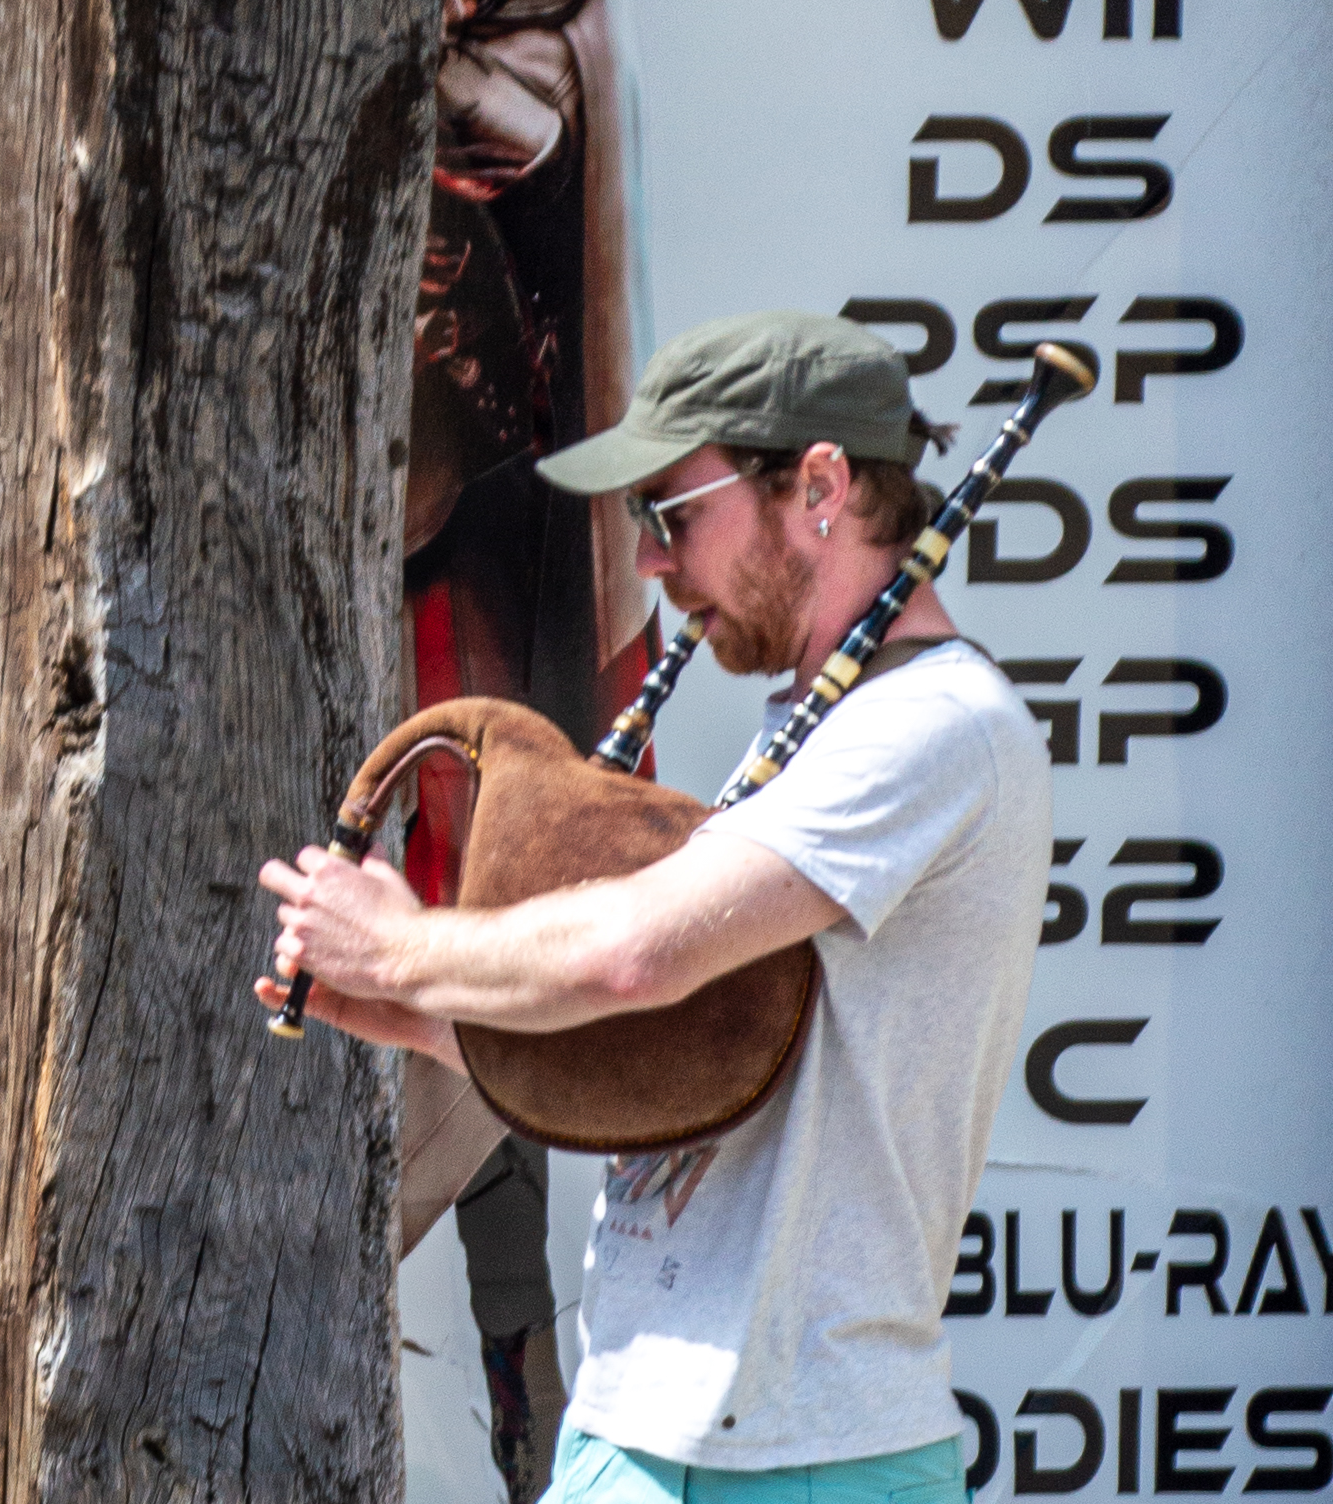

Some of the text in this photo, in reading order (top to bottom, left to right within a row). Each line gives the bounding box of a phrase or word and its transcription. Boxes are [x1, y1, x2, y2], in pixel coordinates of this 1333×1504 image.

[907, 113, 1174, 224] DS
[838, 294, 1245, 404] PSP
[916, 474, 1235, 586] DS
